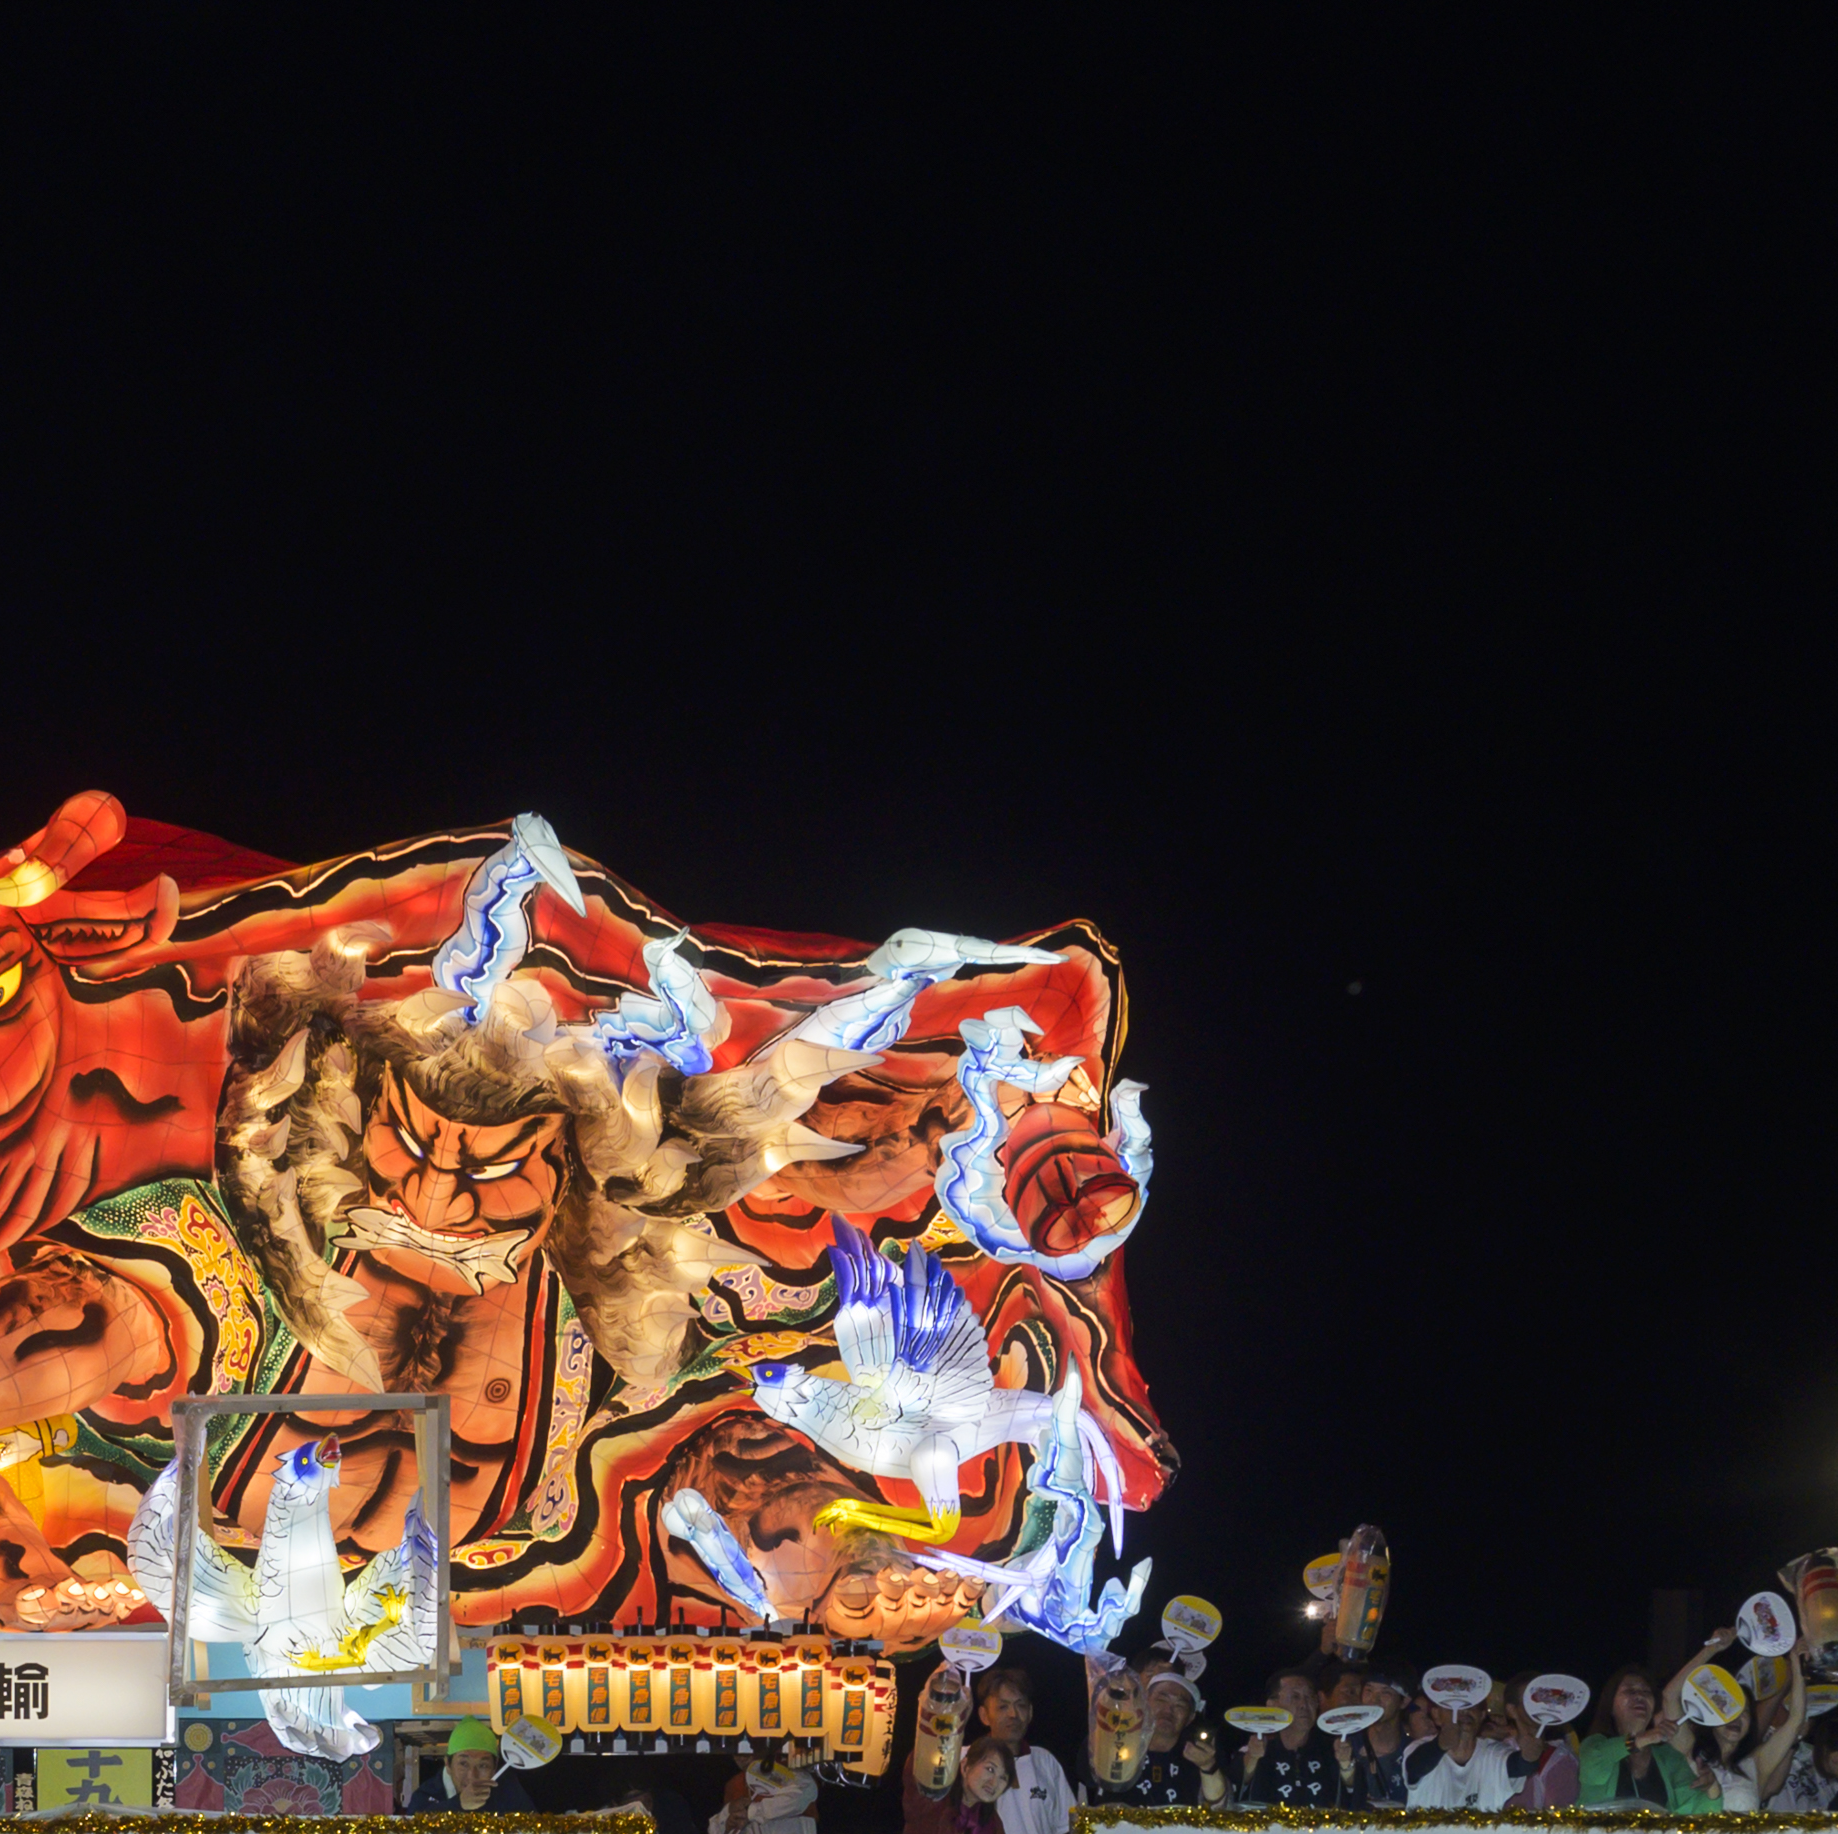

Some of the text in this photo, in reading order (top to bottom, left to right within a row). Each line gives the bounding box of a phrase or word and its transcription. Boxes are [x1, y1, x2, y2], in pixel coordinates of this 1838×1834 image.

[589, 1667, 609, 1723] 宅急便
[631, 1670, 650, 1722] 宅急便
[671, 1669, 692, 1725] 宅急便
[716, 1670, 736, 1727] 宅急便
[760, 1673, 780, 1727] 宅急便
[802, 1670, 822, 1727] 宅急便
[843, 1690, 863, 1744] 宅急便
